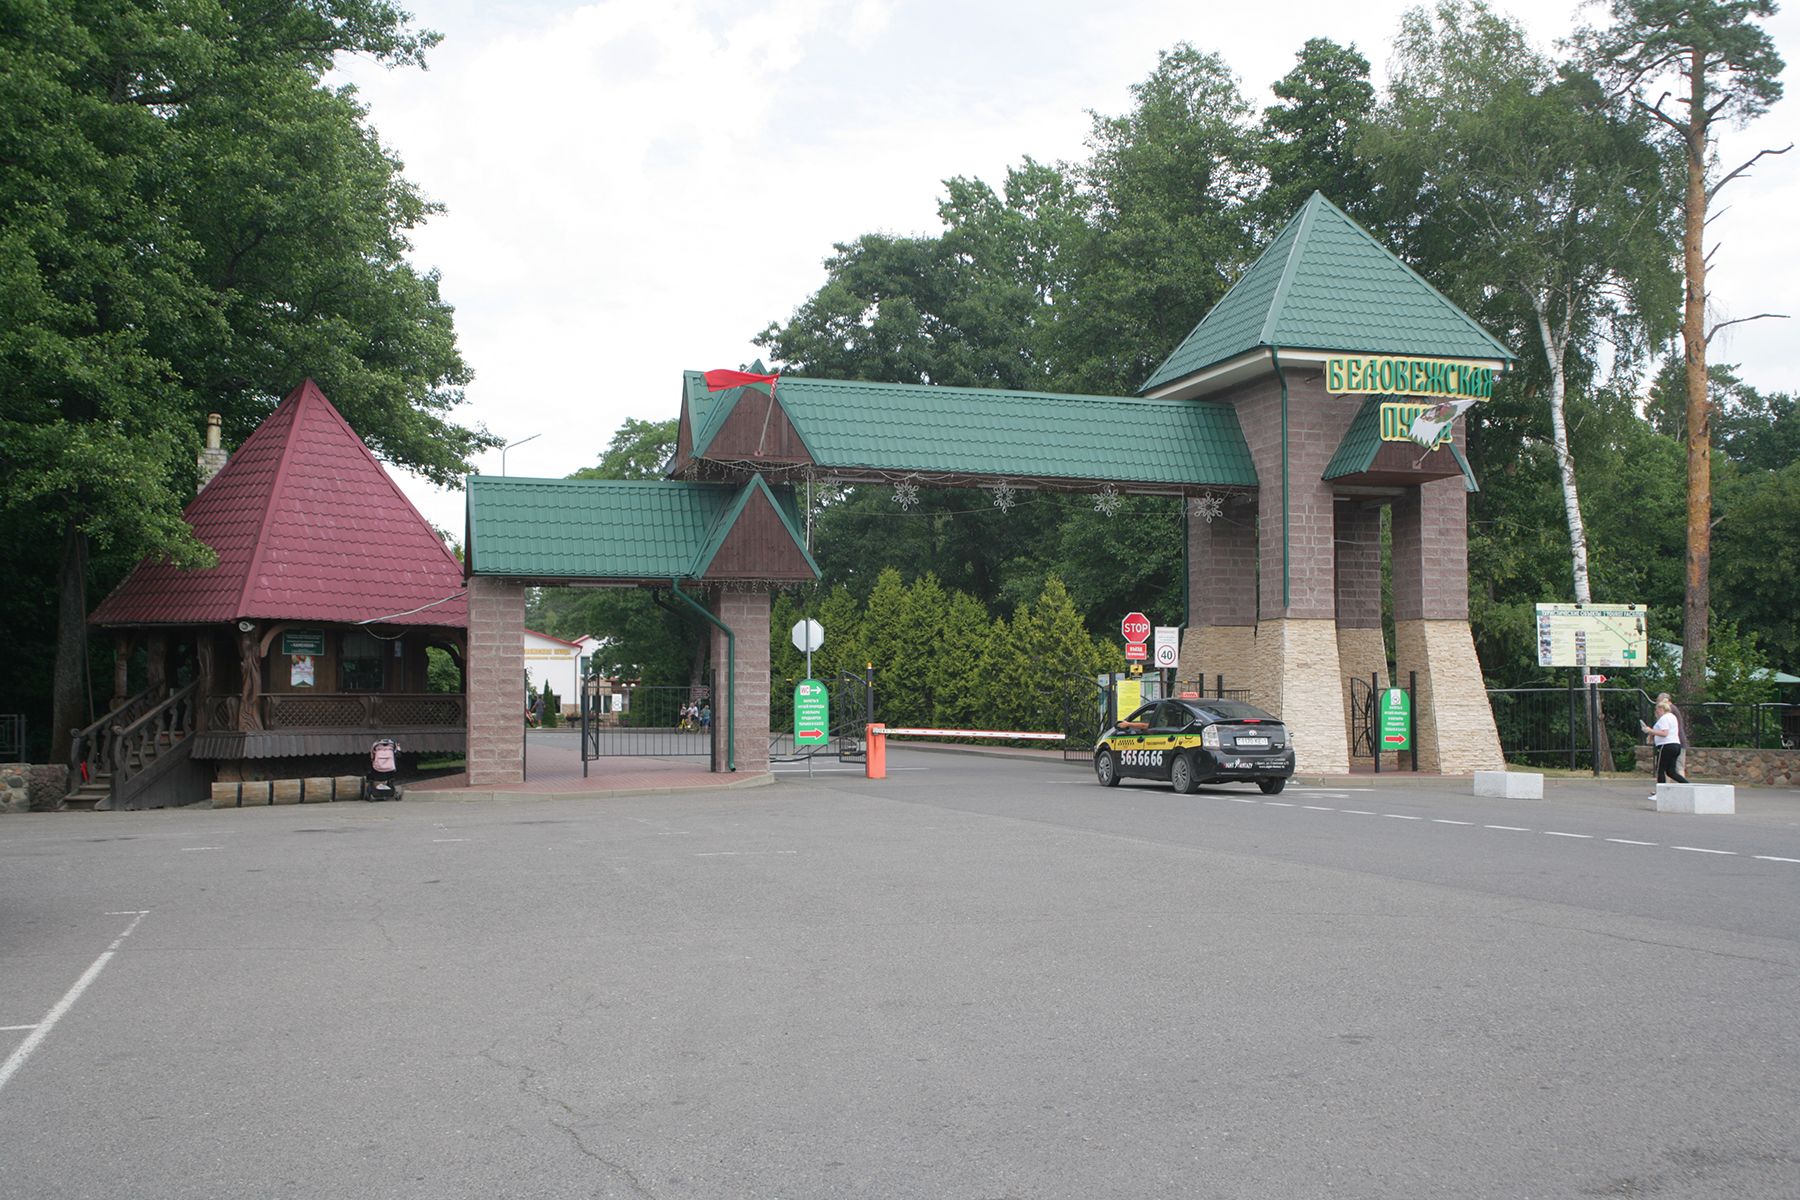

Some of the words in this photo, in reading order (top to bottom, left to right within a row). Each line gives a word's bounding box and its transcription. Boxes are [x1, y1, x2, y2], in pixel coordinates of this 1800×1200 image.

[1328, 357, 1493, 398] БЕЛОВЕЖСКАЯ
[1383, 406, 1452, 446] ПУА
[1124, 623, 1148, 633] STOP
[1161, 650, 1173, 660] 40
[1120, 750, 1163, 766] 5656666
